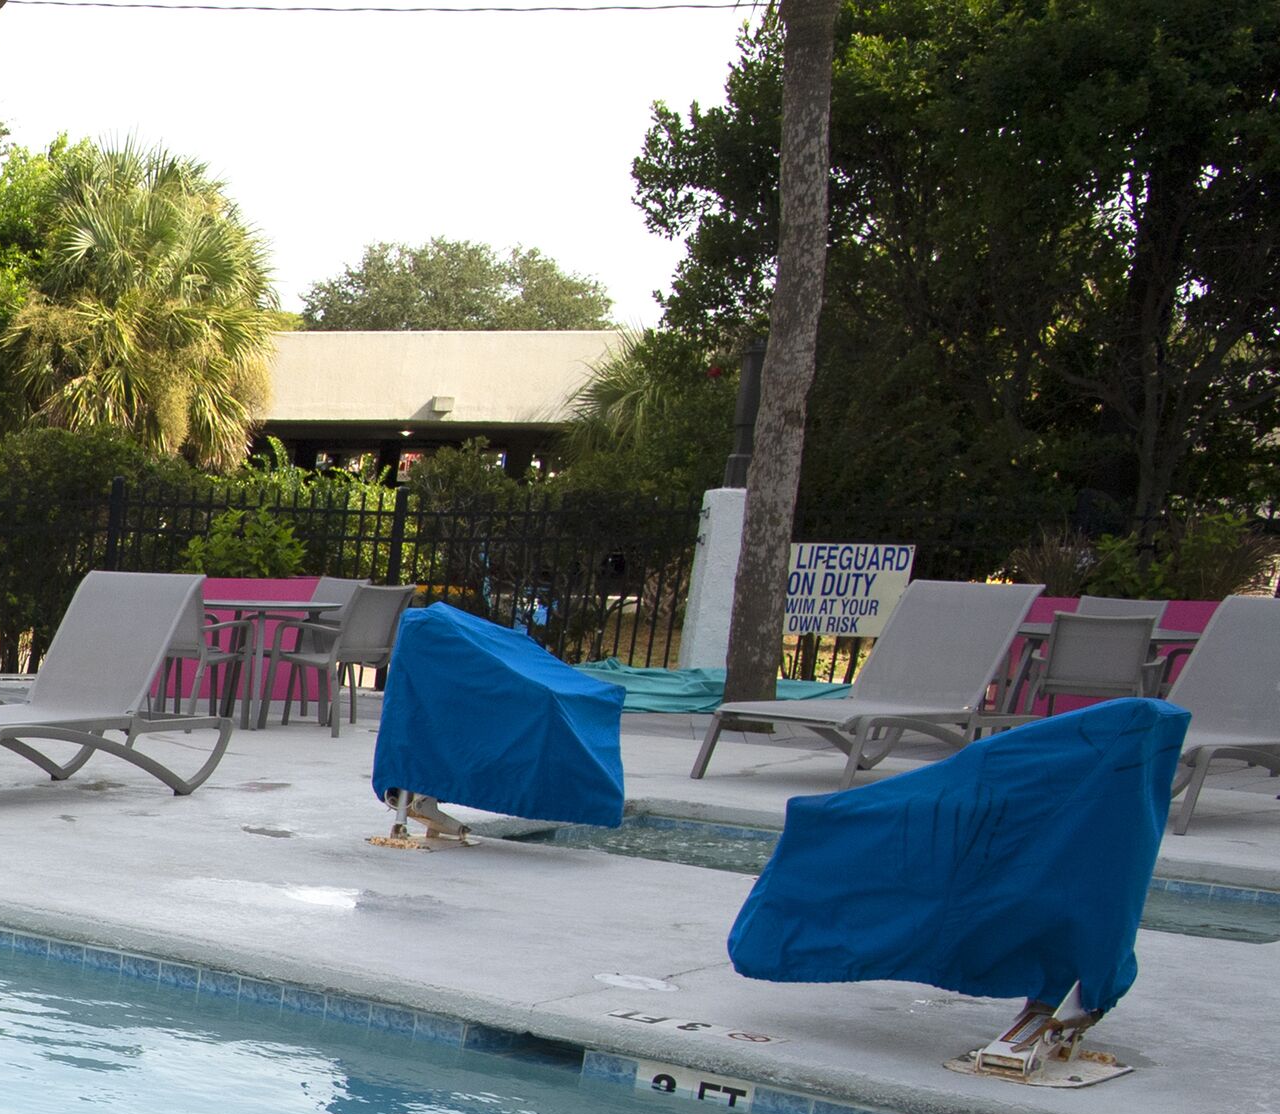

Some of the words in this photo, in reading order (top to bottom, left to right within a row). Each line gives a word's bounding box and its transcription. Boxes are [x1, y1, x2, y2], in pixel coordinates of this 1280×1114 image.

[796, 545, 910, 572] LIFEGUARD
[787, 571, 817, 596] ON
[821, 572, 877, 597] DUTY
[785, 598, 815, 614] WIM
[819, 599, 838, 615] AT
[841, 599, 879, 616] YOUR
[789, 615, 822, 632] OWN
[826, 617, 860, 633] RISK
[698, 1081, 747, 1108] FT
